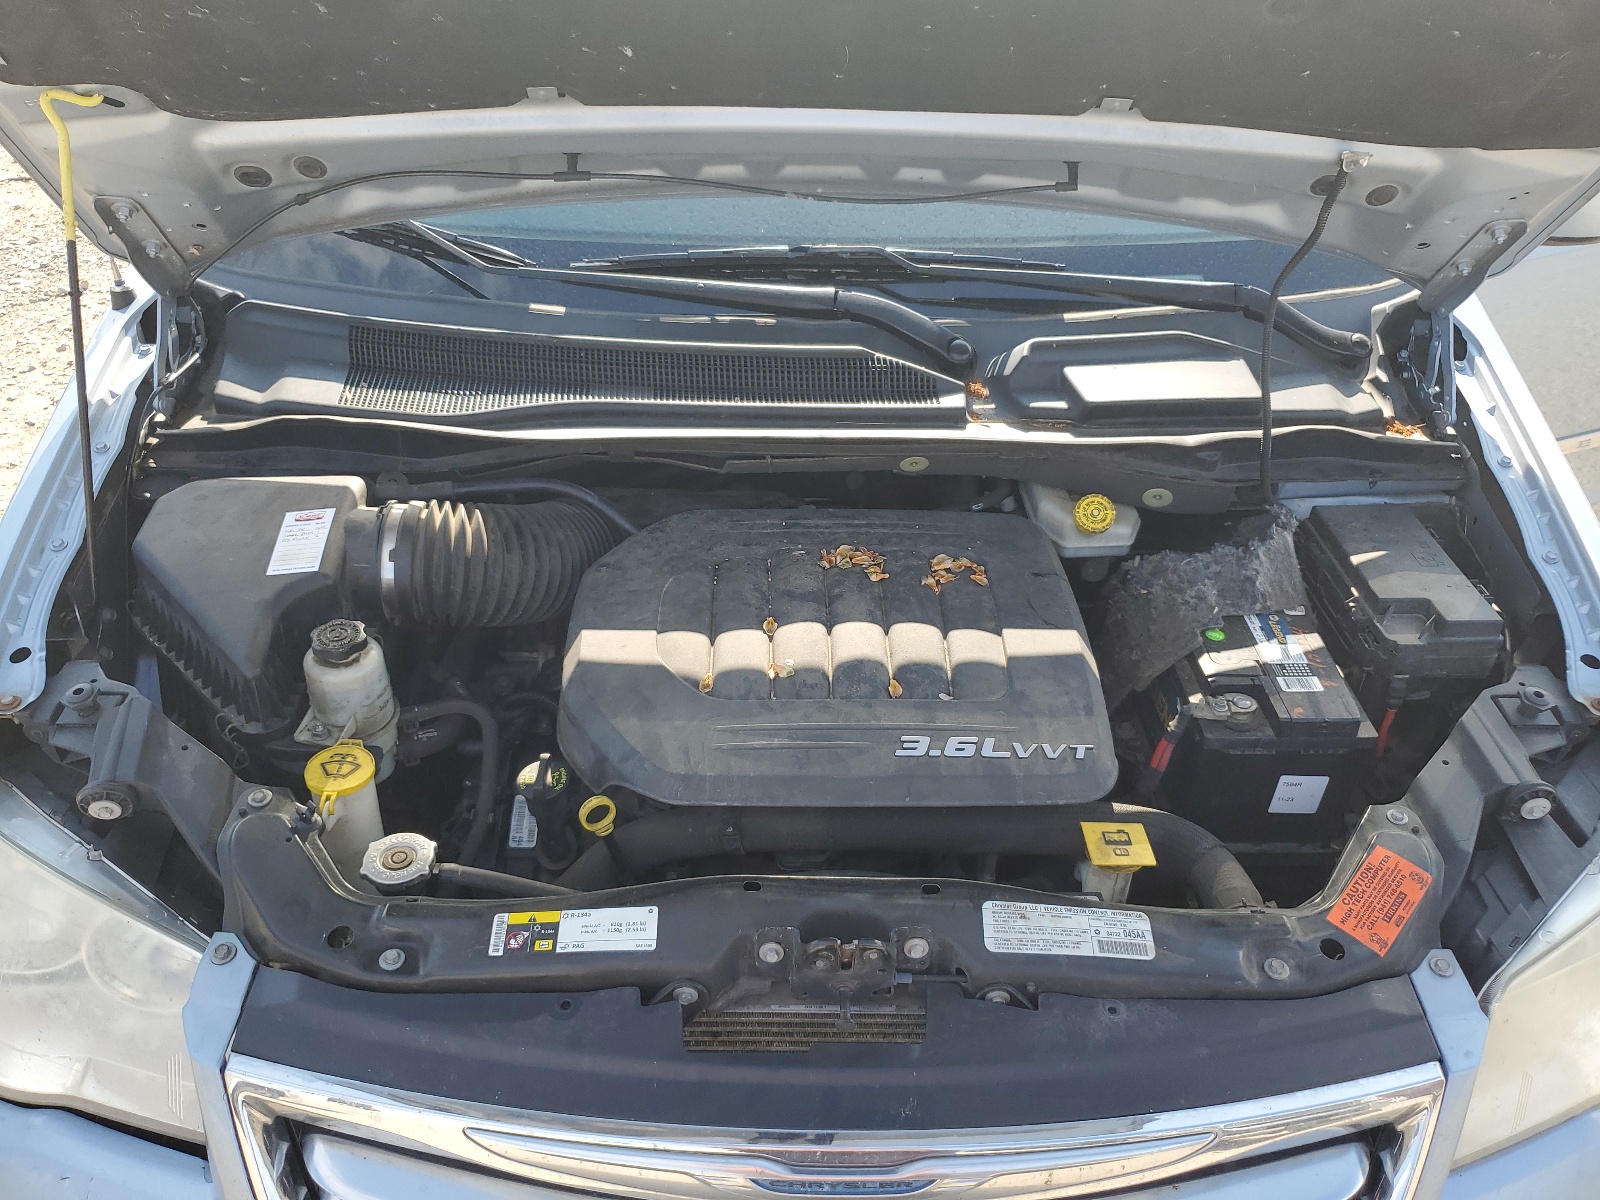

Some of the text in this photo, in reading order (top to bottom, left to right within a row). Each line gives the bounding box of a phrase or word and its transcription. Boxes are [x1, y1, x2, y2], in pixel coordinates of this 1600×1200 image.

[894, 735, 1012, 757] 3.6L
[1339, 854, 1391, 926] HIGH TECH COMPUTER
[1341, 862, 1376, 907] CAUTION!
[1012, 903, 1028, 911] Group
[1087, 909, 1109, 917] CONTROL
[1110, 911, 1143, 919] INFORMATION
[1383, 892, 1407, 923] FIRKINS
[1366, 914, 1380, 931] CALL
